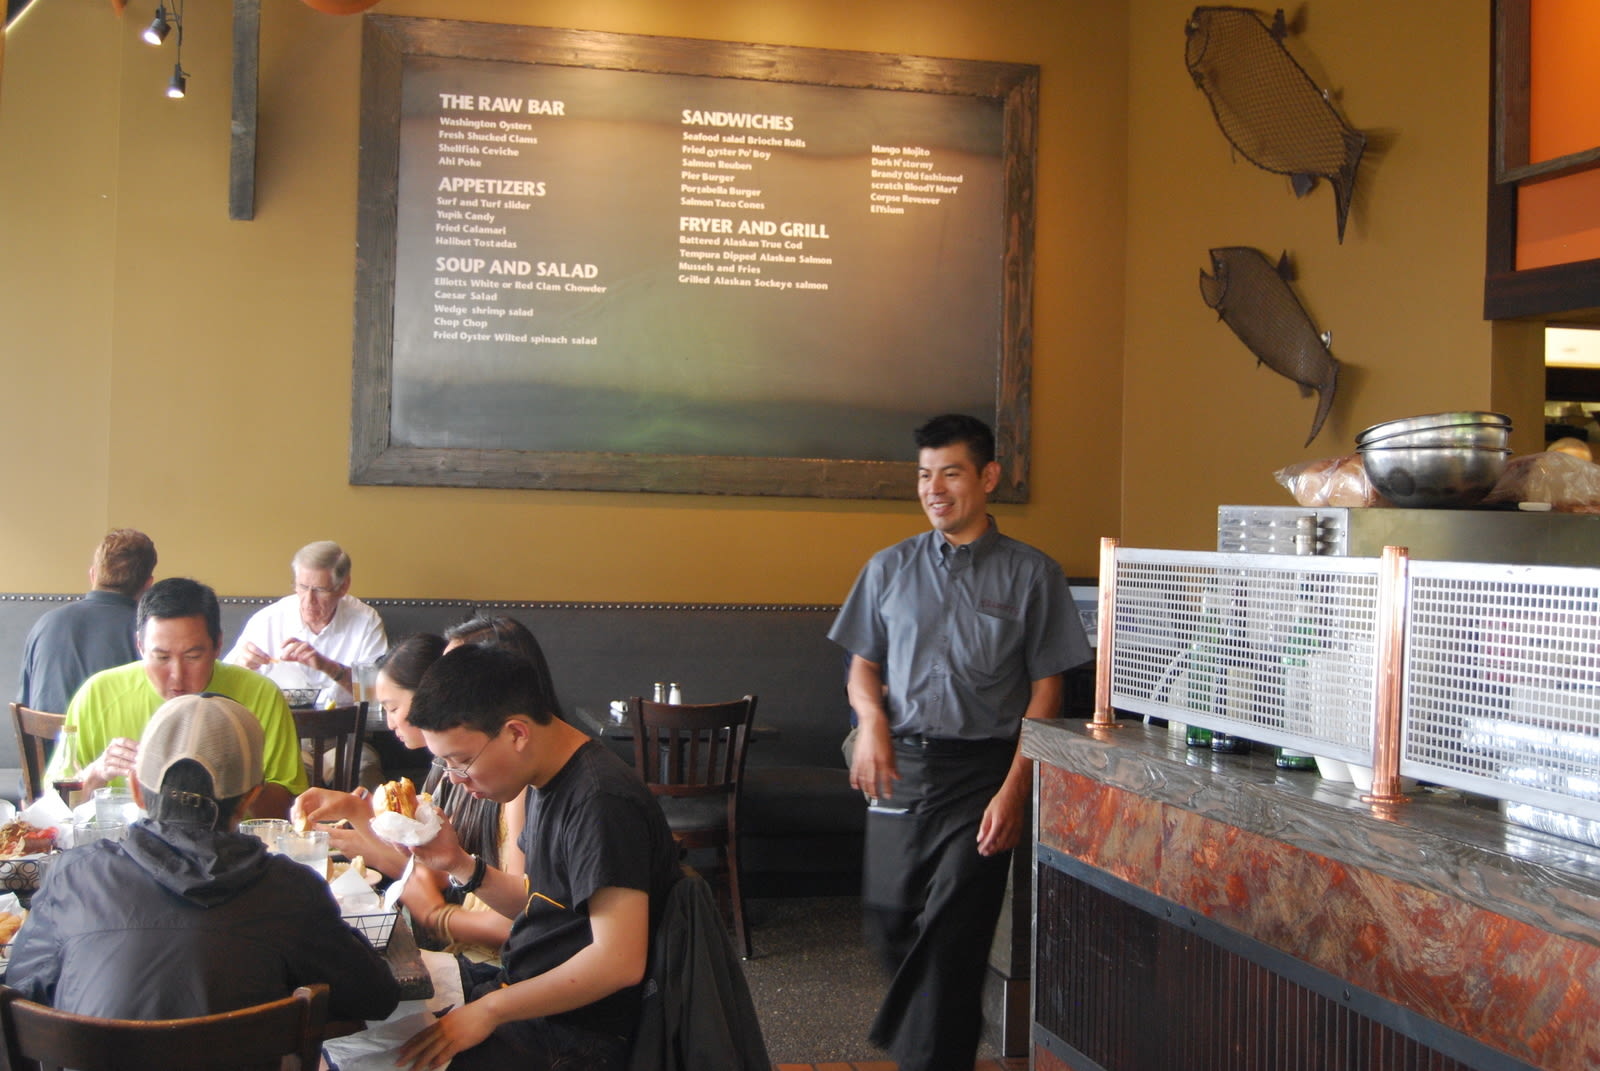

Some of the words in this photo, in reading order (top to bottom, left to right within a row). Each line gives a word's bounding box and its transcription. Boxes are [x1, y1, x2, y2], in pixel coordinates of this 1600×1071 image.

[439, 94, 474, 110] THE
[478, 96, 523, 113] RAW
[528, 99, 565, 115] BAR
[440, 117, 497, 130] Washington
[499, 121, 532, 132] Oysters
[682, 109, 794, 131] SANDWICHES
[439, 131, 464, 139] Fresh
[467, 132, 507, 142] Shucked
[509, 135, 538, 144] Clams
[683, 132, 719, 142] Seafood
[722, 135, 745, 144] salad
[748, 136, 782, 146] Brioche
[784, 139, 806, 148] Rolls
[438, 144, 479, 154] Shellfish
[482, 146, 519, 156] Ceviche
[682, 145, 705, 154] Fried
[753, 150, 771, 160] Boy
[458, 158, 481, 167] Poke
[682, 158, 715, 168] Salmon
[718, 160, 752, 170] Reuben
[871, 158, 892, 166] Dark
[681, 171, 701, 180] Pier
[702, 172, 735, 184] Burger
[904, 172, 919, 180] Old
[920, 172, 963, 183] fashioned
[438, 177, 547, 197] APPETIZERS
[729, 187, 761, 198] Burger
[437, 197, 458, 205] Surf
[459, 199, 478, 207] and
[480, 199, 502, 208] Turf
[504, 201, 531, 210] slider
[681, 197, 713, 207] Salmon
[716, 199, 736, 208] Taco
[738, 200, 765, 210] Cones
[437, 210, 463, 220] Yupik
[465, 212, 495, 223] Candy
[436, 223, 460, 232] Fried
[462, 224, 506, 235] Calamari
[680, 216, 732, 233] FRYER
[738, 220, 777, 236] AND
[781, 222, 829, 239] GRILL
[435, 236, 471, 246] Halibut
[474, 239, 517, 249] Tostadas
[680, 236, 720, 245] Battered
[723, 237, 759, 247] Alaskan
[761, 239, 782, 248] True
[784, 241, 803, 250] Cod
[680, 250, 720, 260] Tempura
[723, 251, 756, 262] Dipped
[760, 254, 796, 262] Alaskan
[799, 255, 832, 265] Salmon
[436, 257, 486, 273] SOUP
[489, 259, 531, 276] AND
[536, 262, 598, 279] SALAD
[679, 262, 714, 271] Mussels
[738, 265, 761, 273] Fries
[471, 279, 499, 288] White
[515, 281, 533, 290] Red
[536, 282, 561, 291] Clam
[565, 283, 607, 293] Chowder
[679, 275, 710, 284] Grilled
[714, 276, 751, 286] Alaskan
[754, 279, 792, 290] Sockeye
[795, 281, 828, 290] salmon
[435, 291, 466, 299] Caesar
[470, 292, 498, 301] Salad
[434, 304, 468, 316] Wedge
[472, 306, 505, 317] shrimp
[508, 308, 534, 316] salad
[434, 318, 459, 328] Chop
[463, 319, 488, 329] Chop
[433, 331, 458, 340] Fried
[460, 332, 491, 343] Oyster
[494, 333, 528, 342] Wilted
[531, 335, 567, 346] spinach
[572, 336, 598, 345] salad
